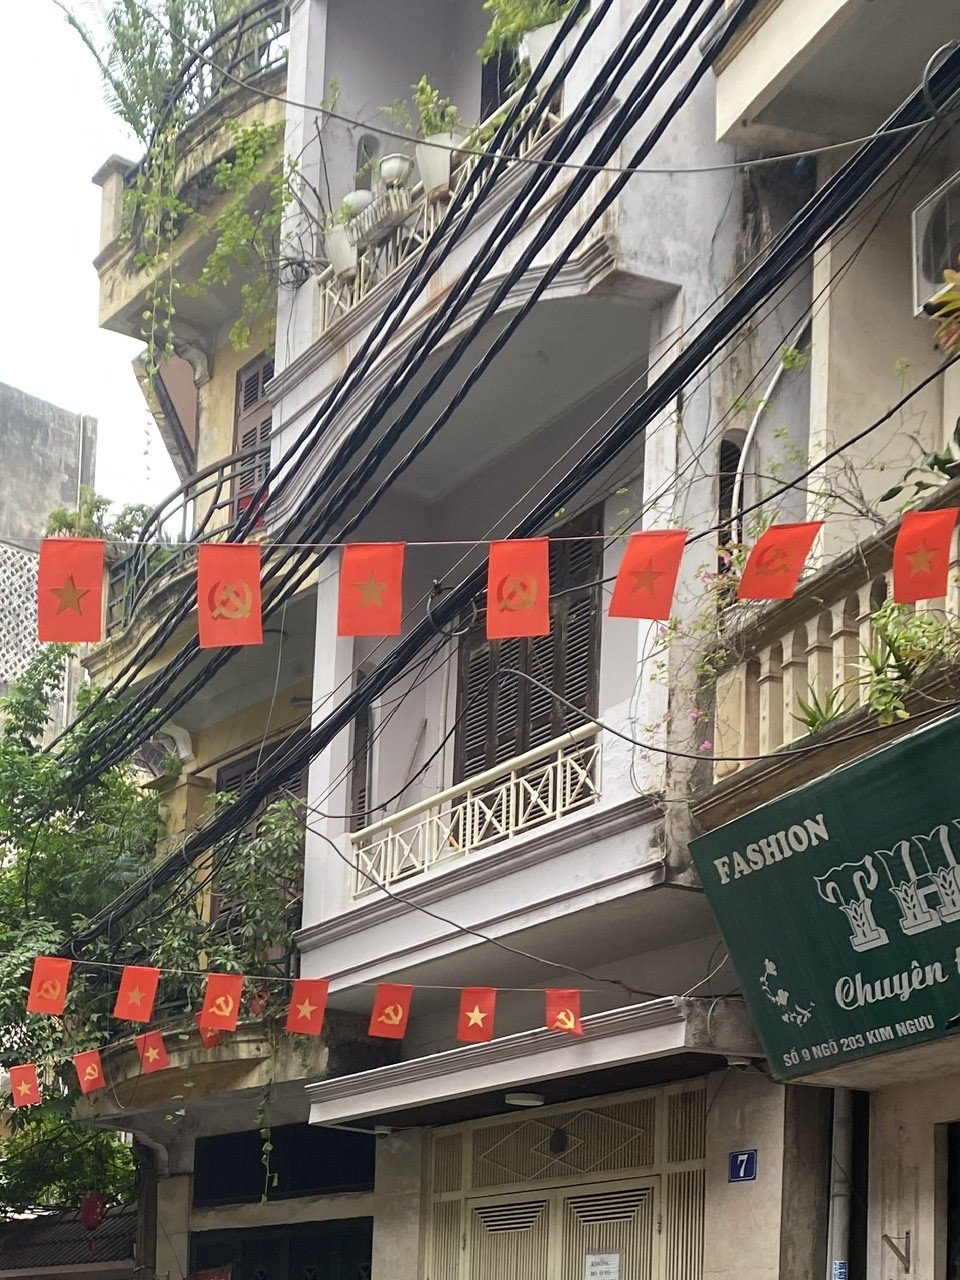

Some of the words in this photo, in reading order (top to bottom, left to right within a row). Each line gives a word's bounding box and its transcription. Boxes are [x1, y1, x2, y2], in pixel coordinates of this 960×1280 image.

[713, 814, 829, 884] FASHION
[813, 819, 960, 952] TH
[835, 960, 948, 1010] Chuyên
[783, 1046, 800, 1067] SỐ
[803, 1048, 811, 1061] 9
[812, 1038, 839, 1059] NGÕ
[840, 1034, 865, 1051] 203
[866, 1026, 895, 1045] KIM
[895, 1014, 935, 1037] NGƯU
[737, 1154, 748, 1177] 7
